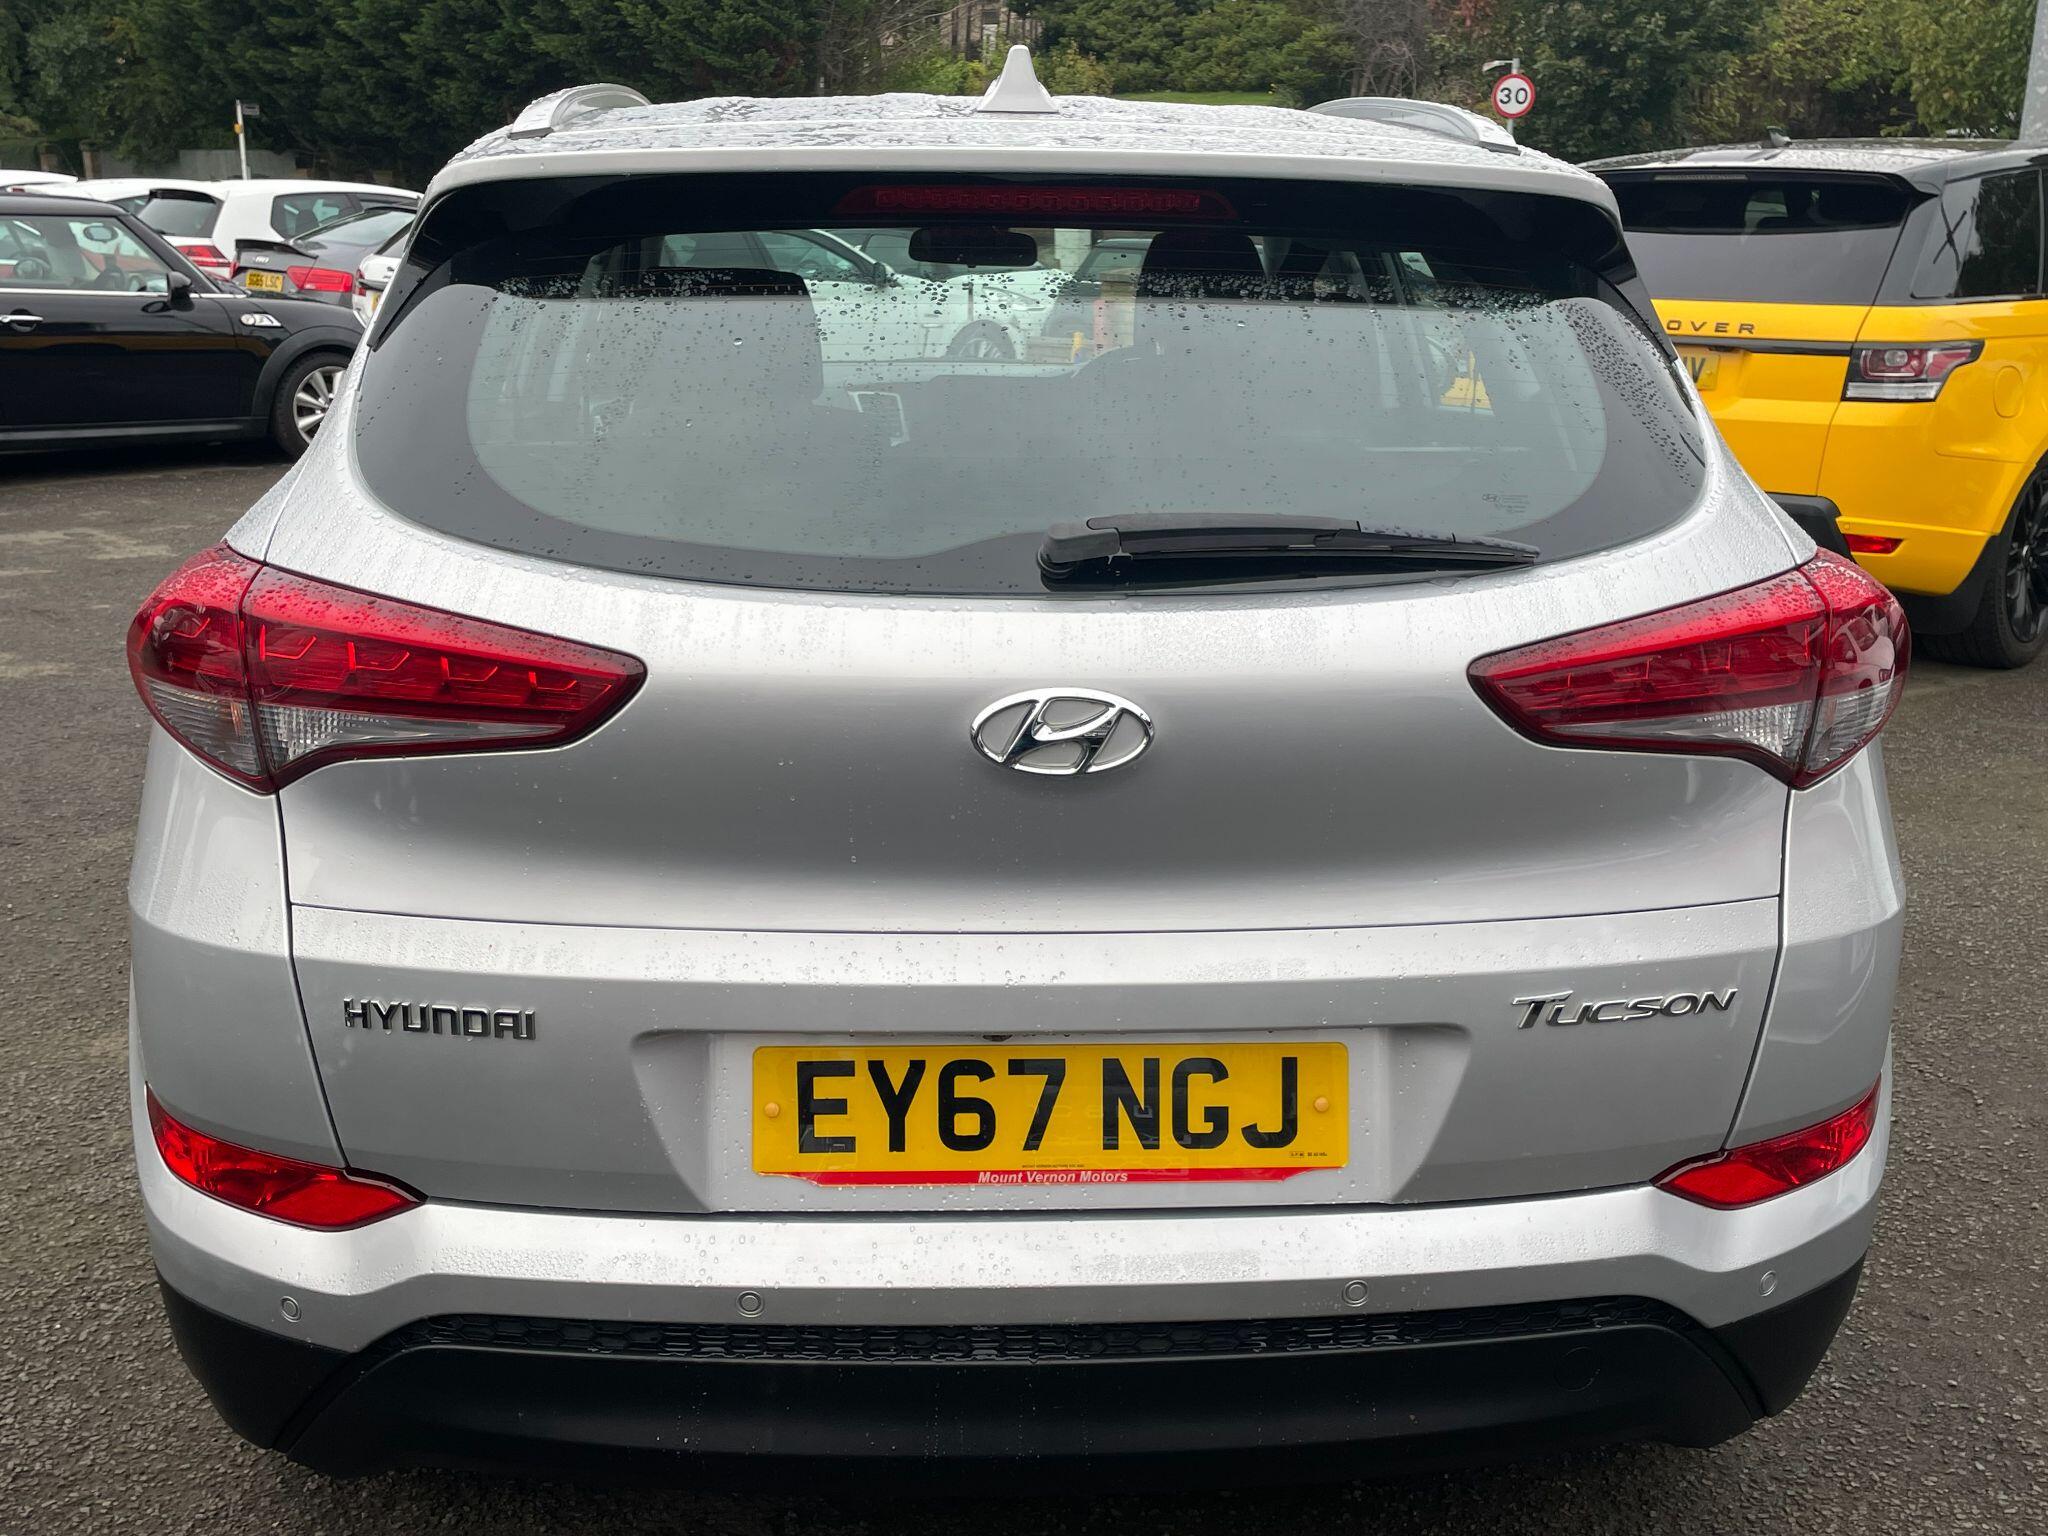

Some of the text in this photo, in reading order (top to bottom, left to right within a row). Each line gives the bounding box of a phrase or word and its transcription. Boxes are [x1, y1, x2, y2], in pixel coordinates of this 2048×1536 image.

[1500, 87, 1527, 104] 30
[1666, 320, 1755, 334] OVER
[343, 998, 537, 1041] HYUNDAI
[796, 1056, 1300, 1154] EY67 NGJ
[978, 1170, 1128, 1184] Mount Vernon Motors
